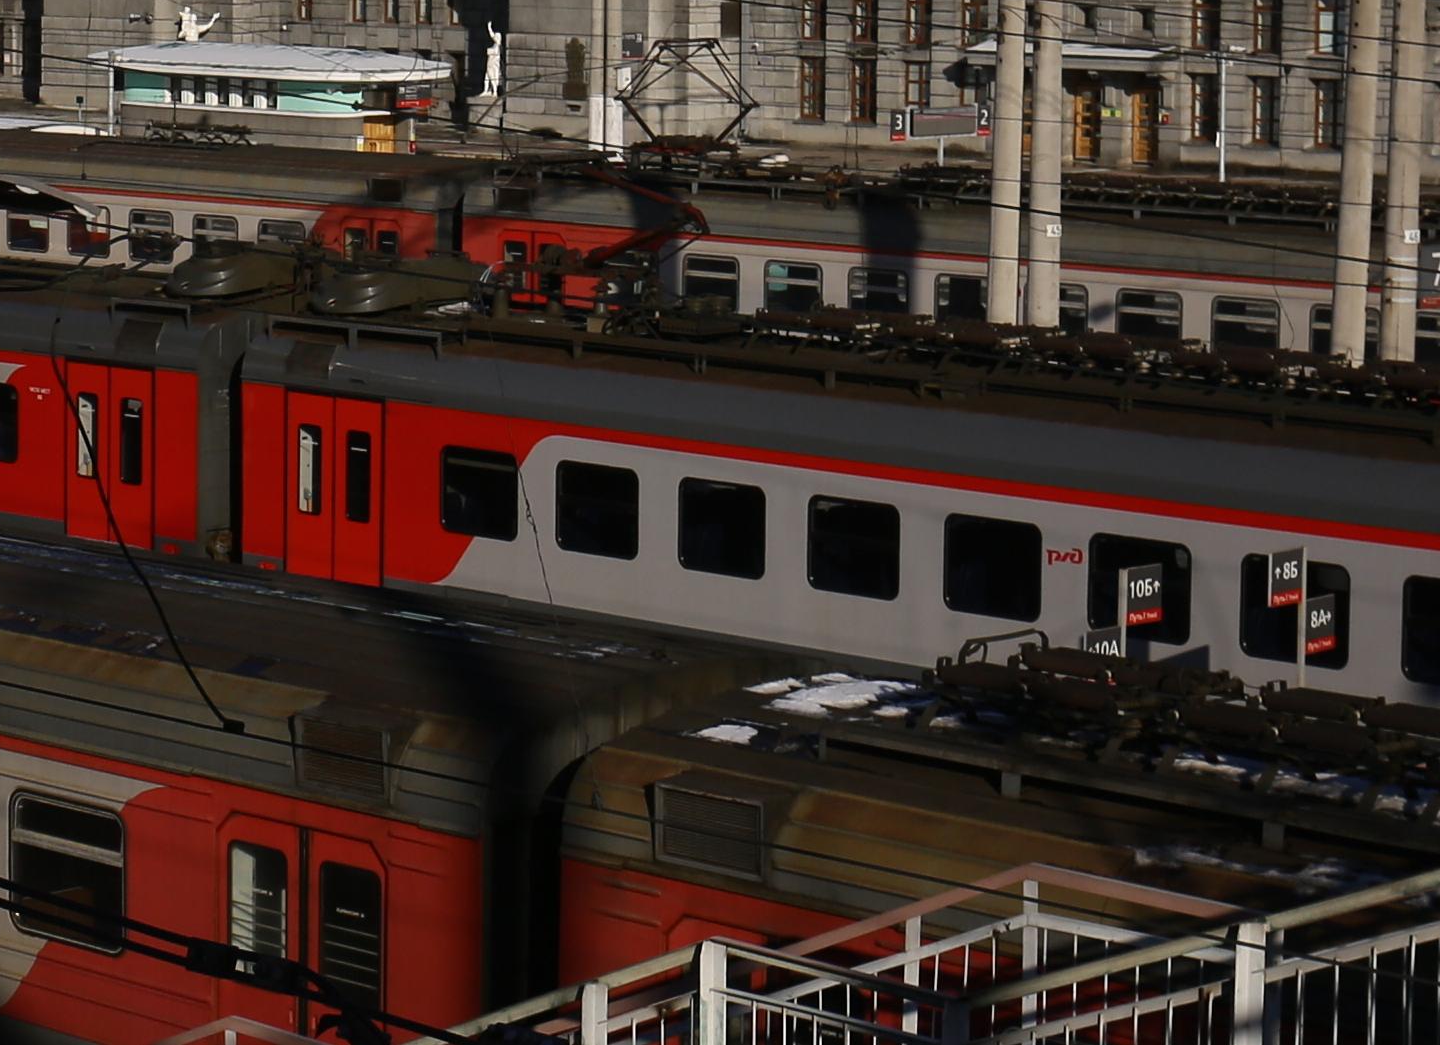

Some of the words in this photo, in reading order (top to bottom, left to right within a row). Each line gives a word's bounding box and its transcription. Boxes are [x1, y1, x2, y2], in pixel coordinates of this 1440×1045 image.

[895, 114, 903, 130] 3
[980, 109, 989, 125] 2
[1282, 560, 1298, 580] 8Б
[1129, 578, 1153, 599] 10Б
[1311, 609, 1327, 629] 8А
